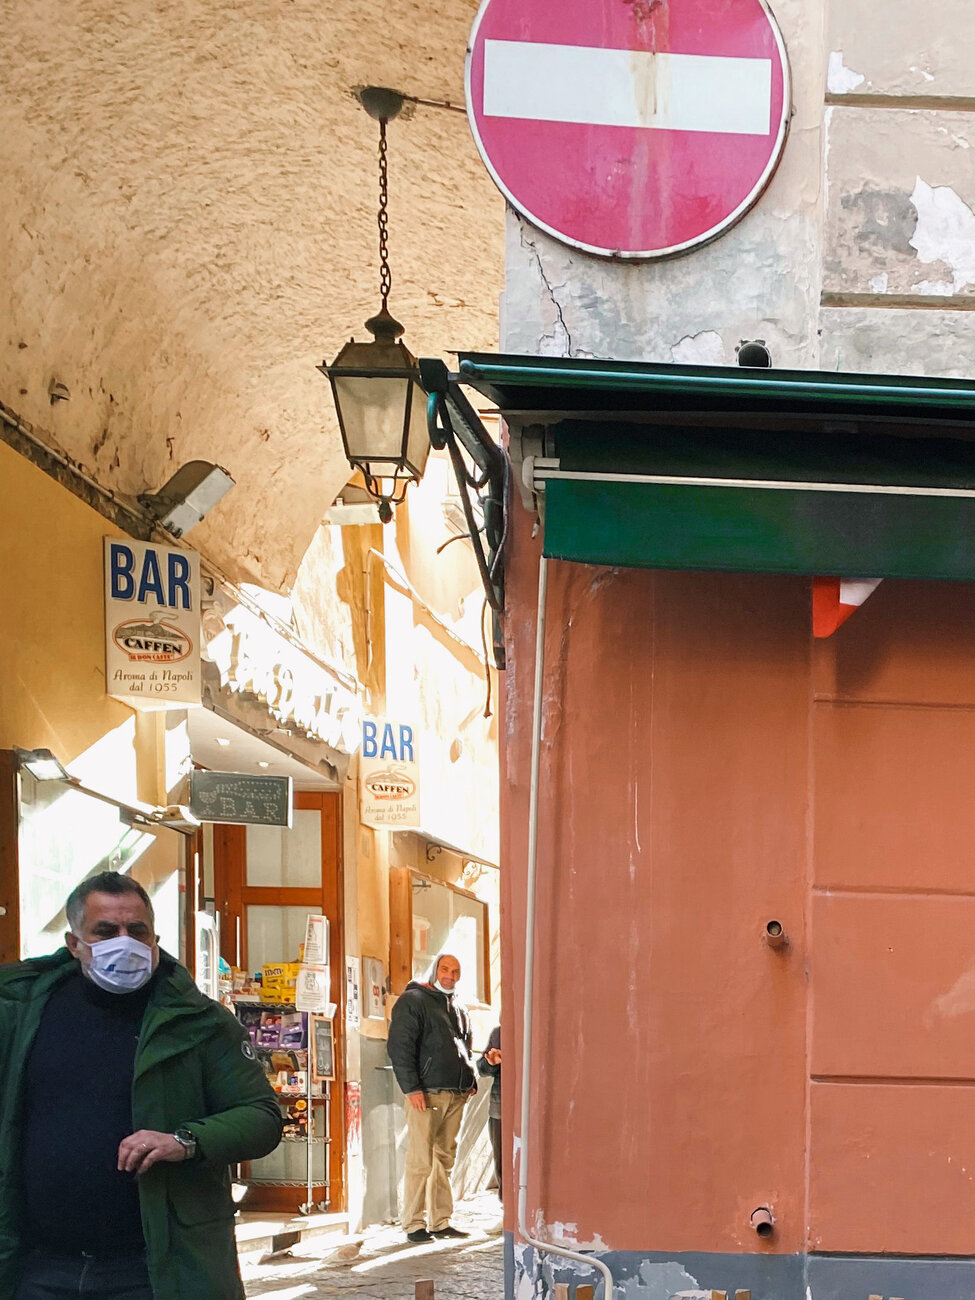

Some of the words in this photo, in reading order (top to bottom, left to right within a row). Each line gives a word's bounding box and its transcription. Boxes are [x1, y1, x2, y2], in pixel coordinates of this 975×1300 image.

[110, 543, 192, 611] BAR
[124, 637, 183, 656] CAFFEN
[113, 669, 145, 681] Aroma
[149, 670, 158, 681] di
[162, 669, 193, 684] Napoli
[129, 682, 143, 692] dal
[363, 721, 414, 762] BAR
[371, 783, 409, 795] CAFFEN
[220, 797, 280, 821] BAR
